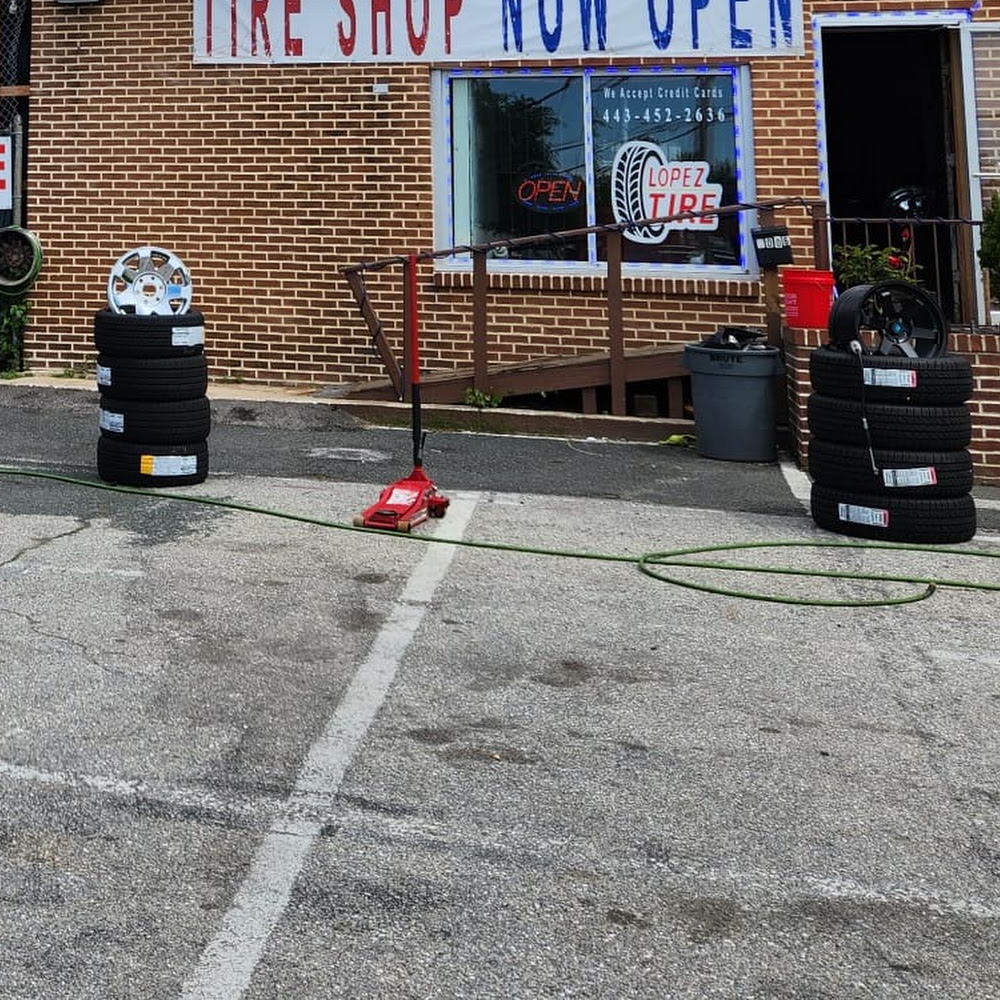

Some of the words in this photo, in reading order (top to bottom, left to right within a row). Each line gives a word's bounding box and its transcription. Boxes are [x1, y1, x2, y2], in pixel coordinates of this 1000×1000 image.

[603, 87, 616, 99] We
[620, 87, 654, 101] Accept
[657, 86, 690, 99] Credit
[693, 86, 723, 99] Cards
[602, 107, 726, 123] 443-452-2636
[648, 167, 705, 188] LOPEZ
[517, 179, 582, 202] OPEN
[648, 192, 717, 224] TIRE
